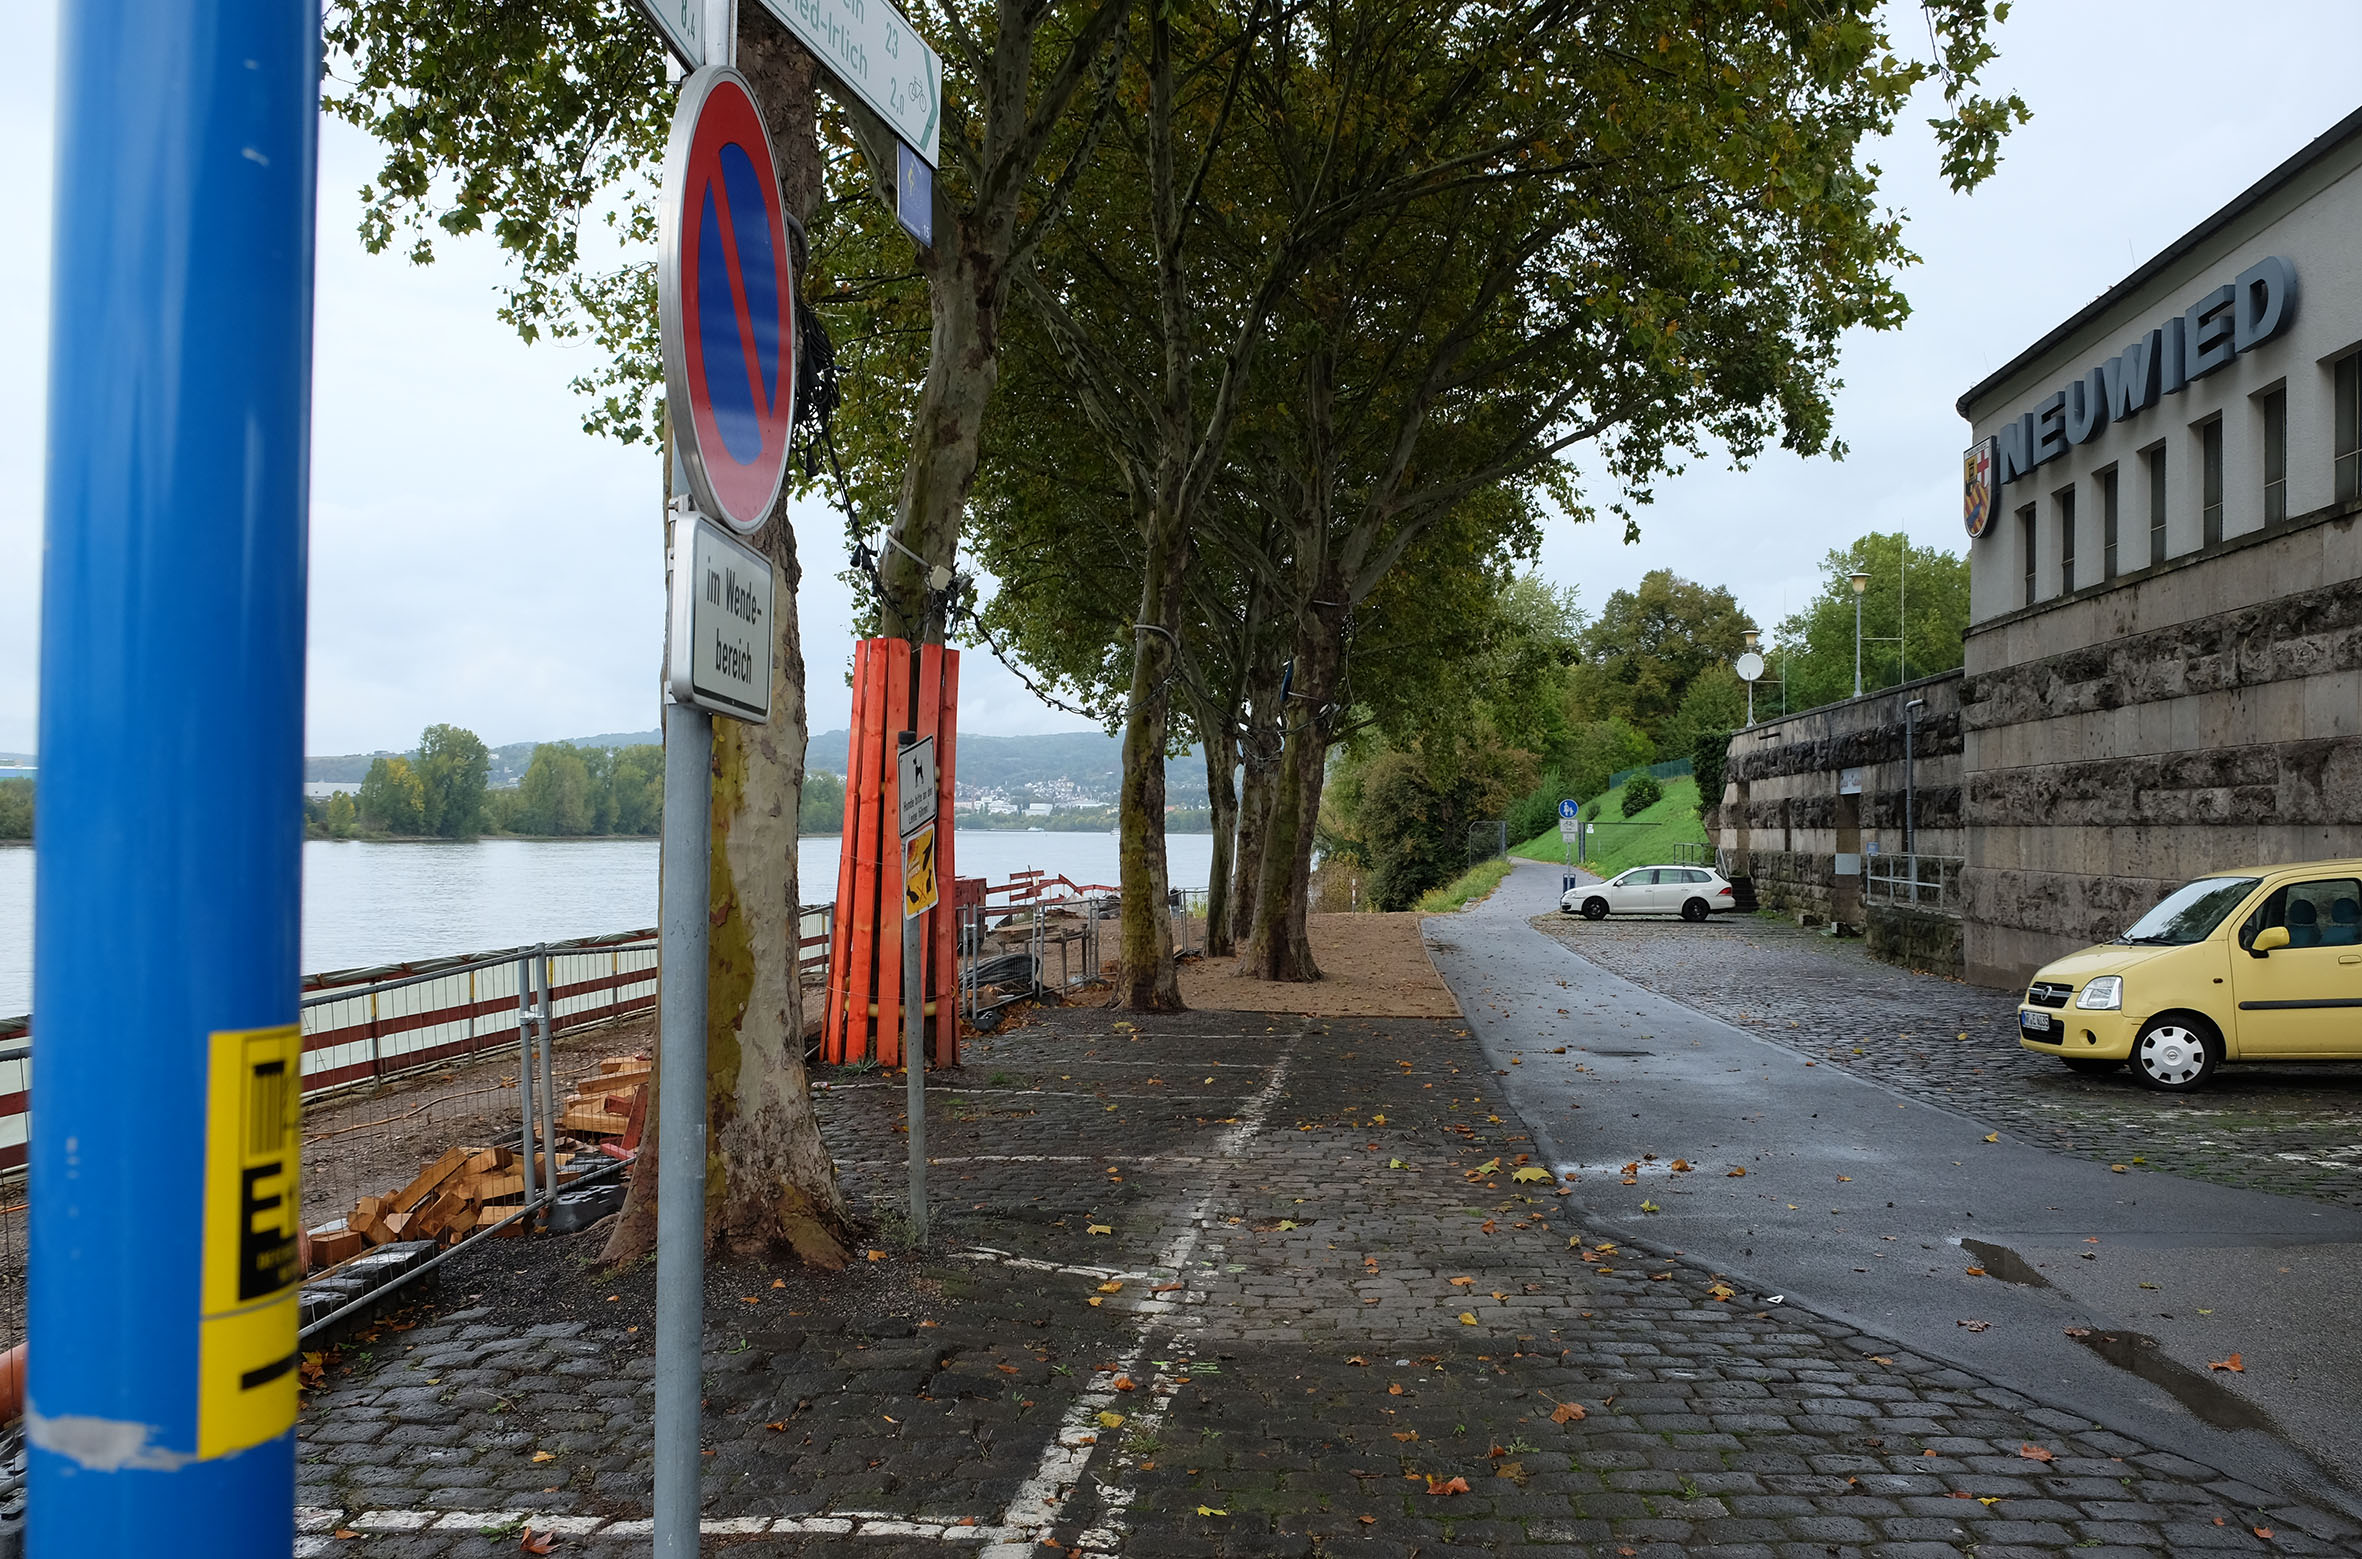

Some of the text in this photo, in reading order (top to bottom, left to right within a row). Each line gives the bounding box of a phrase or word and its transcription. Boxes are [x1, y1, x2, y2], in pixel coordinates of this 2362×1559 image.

[885, 22, 899, 60] 23
[890, 77, 905, 115] 2,0
[1999, 256, 2298, 485] NEUWIED
[706, 555, 762, 625] im Wende-
[715, 627, 752, 685] bereich
